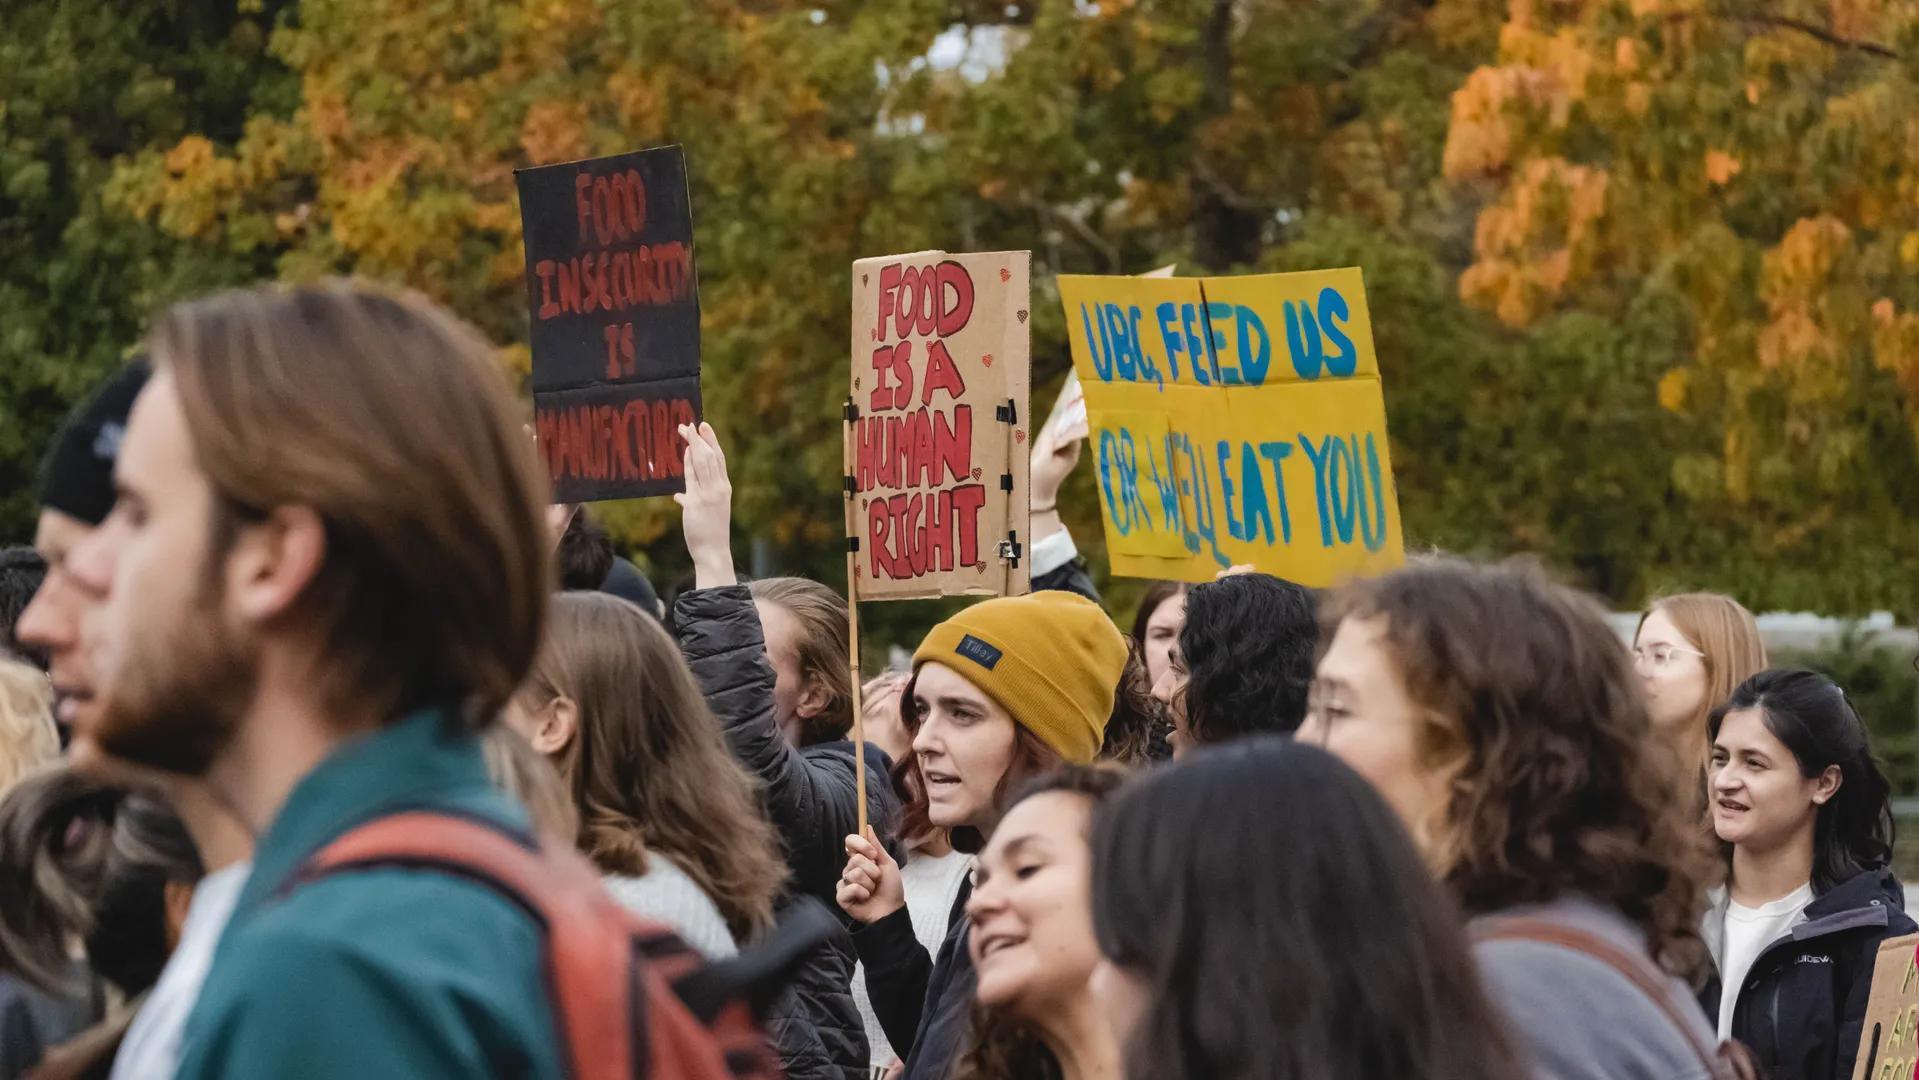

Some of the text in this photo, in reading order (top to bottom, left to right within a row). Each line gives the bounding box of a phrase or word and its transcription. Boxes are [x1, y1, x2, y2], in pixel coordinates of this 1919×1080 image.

[576, 168, 646, 246] FOOD
[878, 260, 975, 342] FOOD
[1081, 287, 1357, 392] UBC, FEED US
[604, 323, 636, 379] IS
[871, 339, 965, 412] IS A
[856, 403, 972, 493] HUMAN
[1100, 426, 1153, 537] OR
[1217, 439, 1294, 547] EAT
[1297, 431, 1387, 553] YOU
[869, 484, 985, 580] RIGHT
